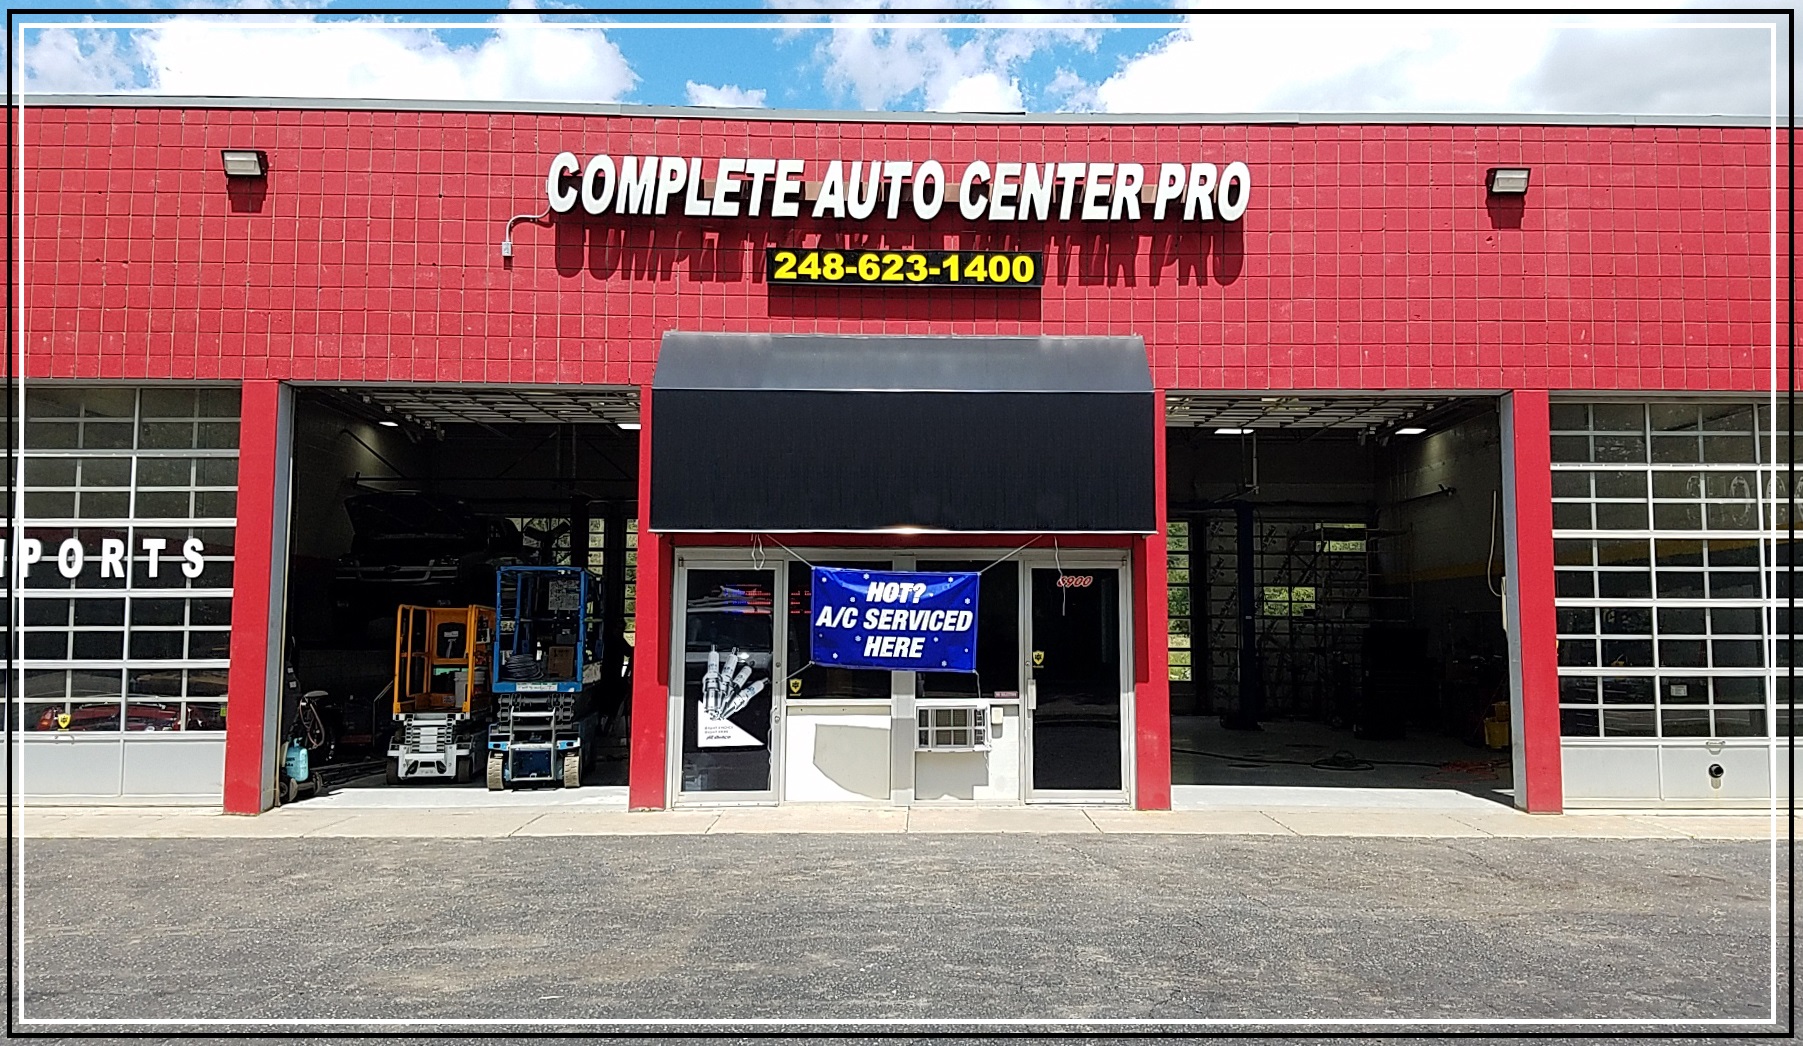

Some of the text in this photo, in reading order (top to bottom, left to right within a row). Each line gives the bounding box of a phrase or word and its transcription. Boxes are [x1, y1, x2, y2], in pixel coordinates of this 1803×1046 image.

[548, 152, 1251, 221] COMPLETE AUTO CENTER PRO
[774, 251, 1035, 283] 248-623-1400
[866, 581, 927, 604] HOT?
[815, 605, 973, 632] A/C SERVICED
[863, 635, 926, 658] HERE
